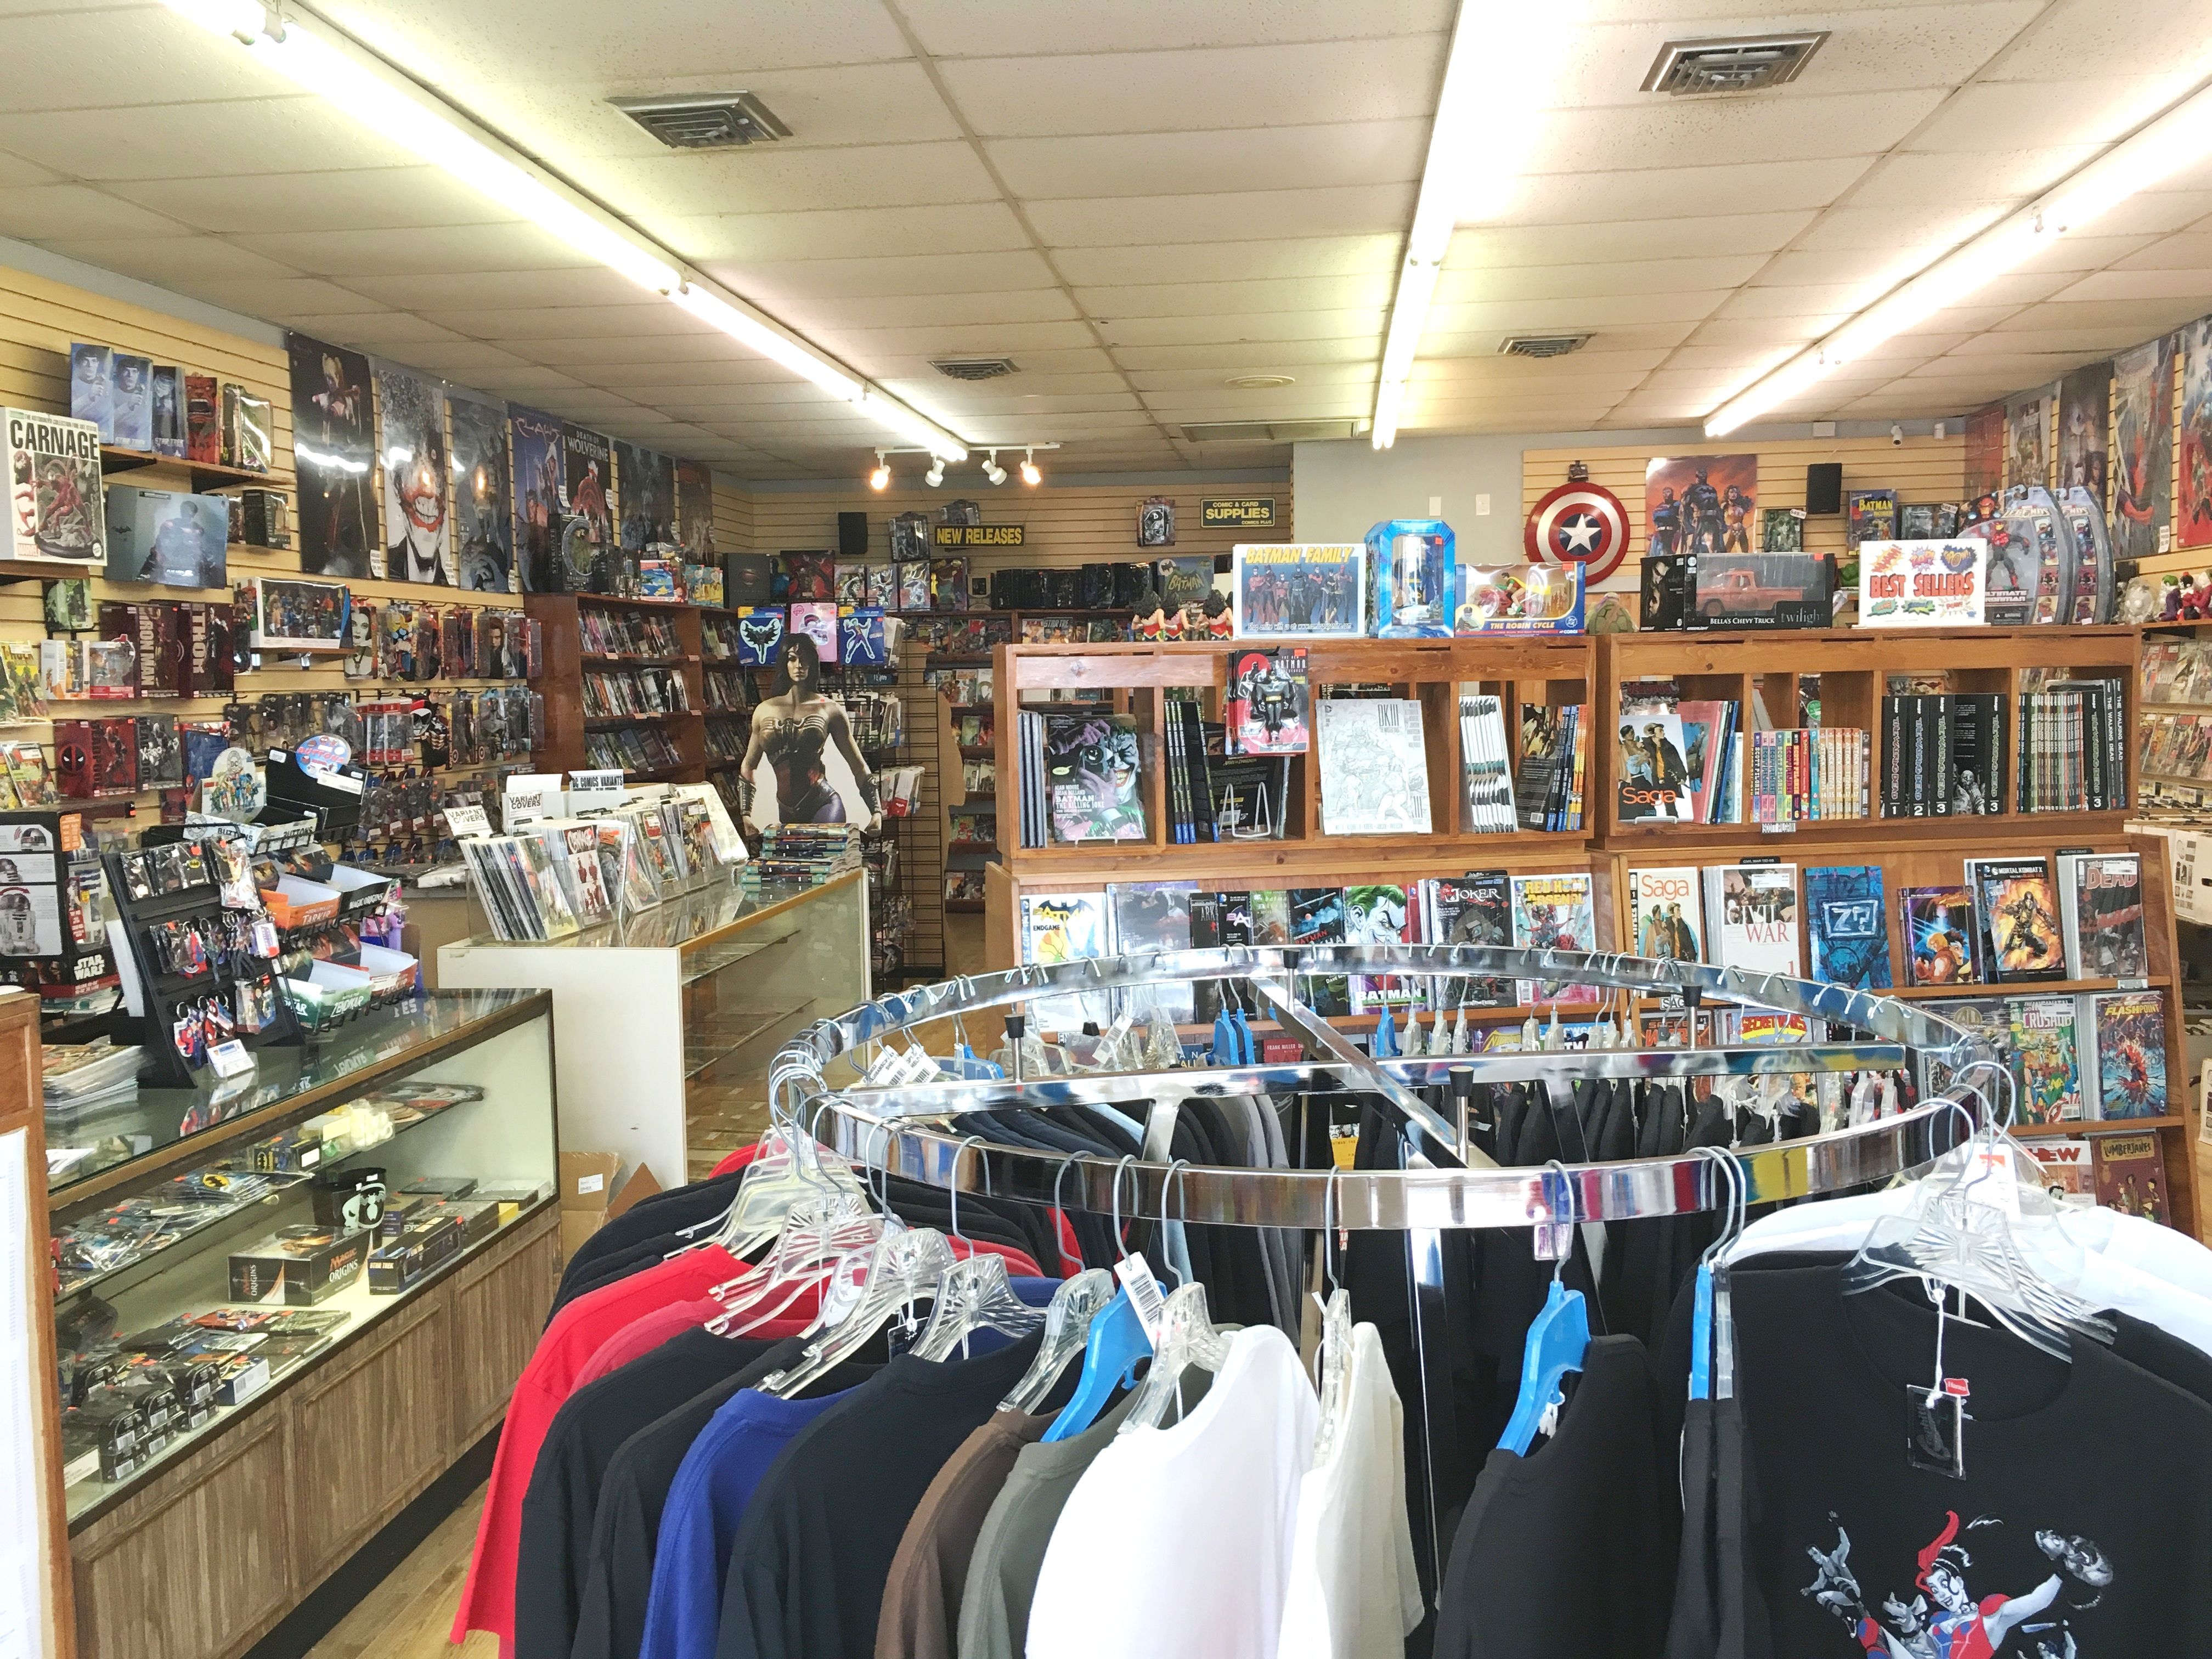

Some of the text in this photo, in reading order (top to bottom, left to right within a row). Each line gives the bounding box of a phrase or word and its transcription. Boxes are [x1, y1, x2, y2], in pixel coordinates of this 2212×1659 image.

[10, 419, 98, 460] CARNAGE
[567, 437, 608, 461] WOLVERINE
[1206, 507, 1269, 519] SUPPLIES
[1859, 499, 1893, 512] BATMAN
[937, 528, 1022, 544] NEW RELEASES
[1245, 546, 1355, 565] BATMAN FAMILY
[1168, 573, 1204, 591] BATMAN
[1870, 571, 1975, 599] BEST SELLERS
[140, 653, 155, 685] MAN
[1992, 714, 2000, 734] THE
[1891, 716, 1900, 800] THE WALKING DEAD
[1915, 716, 1923, 801] THE WALKING DEAD
[1937, 715, 1946, 799] THE WALKING DEAD
[572, 775, 623, 788] DC COMICS VARIANTS
[509, 793, 541, 804] VARIANT
[1622, 786, 1677, 806] Saga
[2094, 798, 2102, 808] 3
[2112, 799, 2116, 807] 1
[2119, 796, 2125, 806] 2
[511, 800, 540, 809] COVERS
[1892, 806, 1897, 815] 1
[1914, 805, 1923, 816] 2
[1937, 803, 1946, 813] 3
[1990, 802, 1998, 812] 3
[1794, 810, 1799, 819] 6
[2086, 868, 2138, 890] DEAD
[1445, 888, 1502, 902] JOKER
[1525, 881, 1550, 894] RED
[1641, 874, 1690, 901] Saga
[303, 910, 331, 926] TARKIR
[1727, 905, 1777, 925] CIVIL
[1746, 923, 1790, 943] WAR
[74, 954, 104, 970] STAR
[1787, 960, 1796, 976] 1
[74, 964, 105, 980] WARS
[1356, 988, 1422, 1001] BATMAN
[2105, 1004, 2159, 1016] FLASHPOINT
[1741, 1015, 1807, 1034] SECRET WARS
[2103, 1142, 2151, 1157] LUMBERJANES
[330, 1248, 357, 1270] MAGIC
[329, 1259, 358, 1283] ORIGINS
